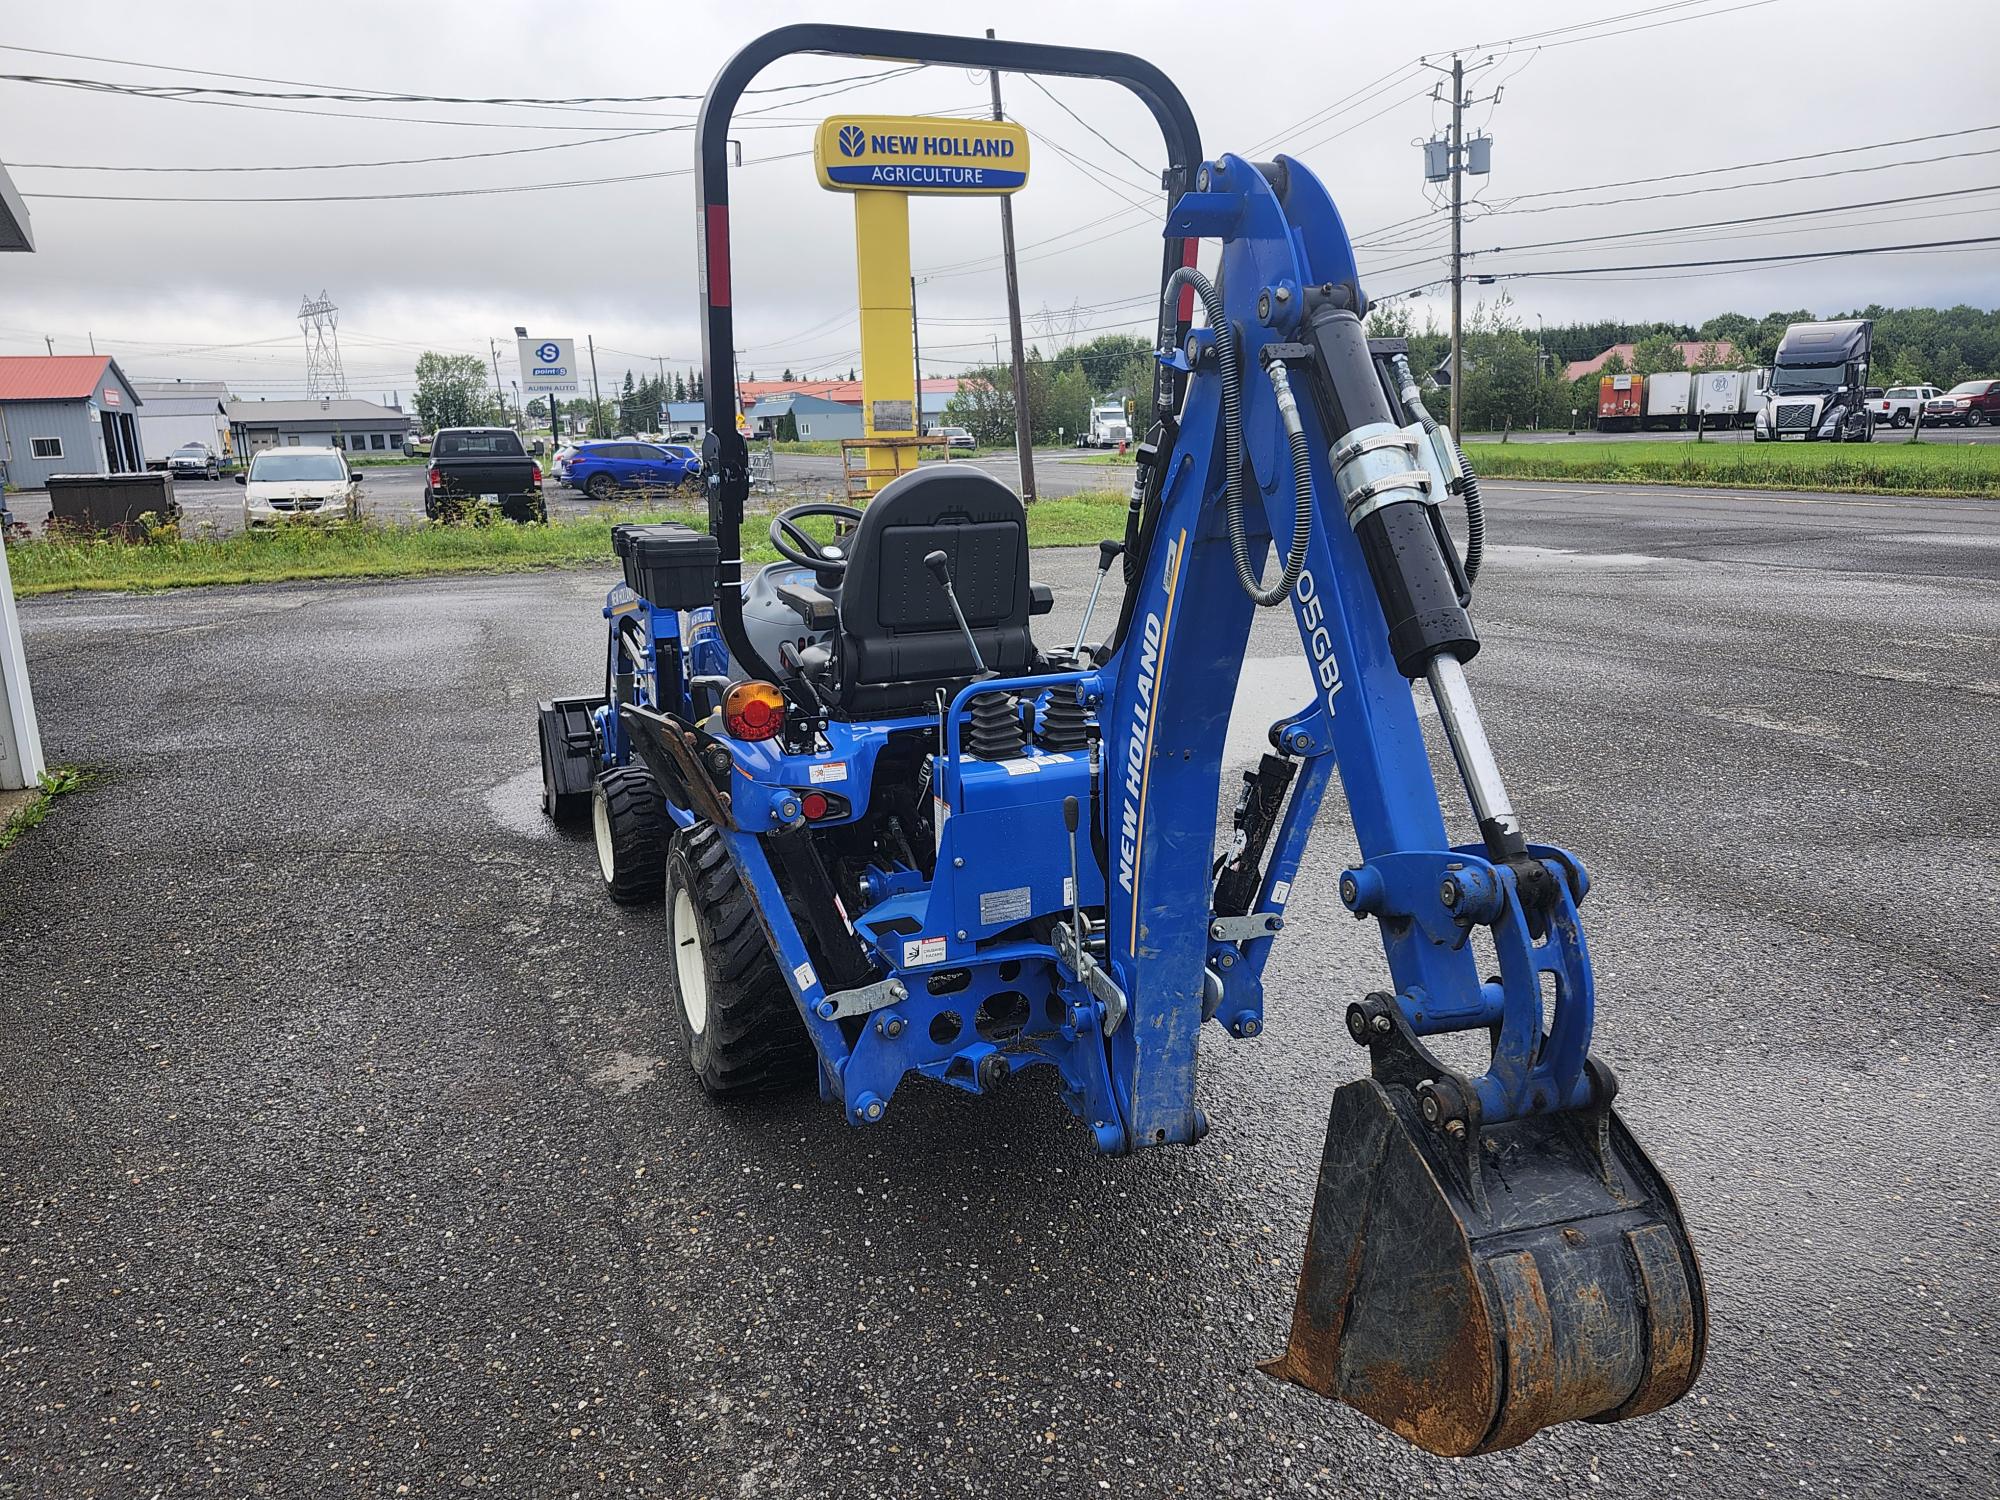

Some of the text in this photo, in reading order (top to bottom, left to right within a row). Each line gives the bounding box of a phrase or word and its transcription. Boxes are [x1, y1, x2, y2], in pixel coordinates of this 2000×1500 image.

[871, 134, 1014, 159] NEW HOLLAND
[871, 166, 983, 184] AGRICULTURE
[1293, 562, 1344, 718] 05GBL
[1118, 612, 1162, 894] NEW HOLLAND
